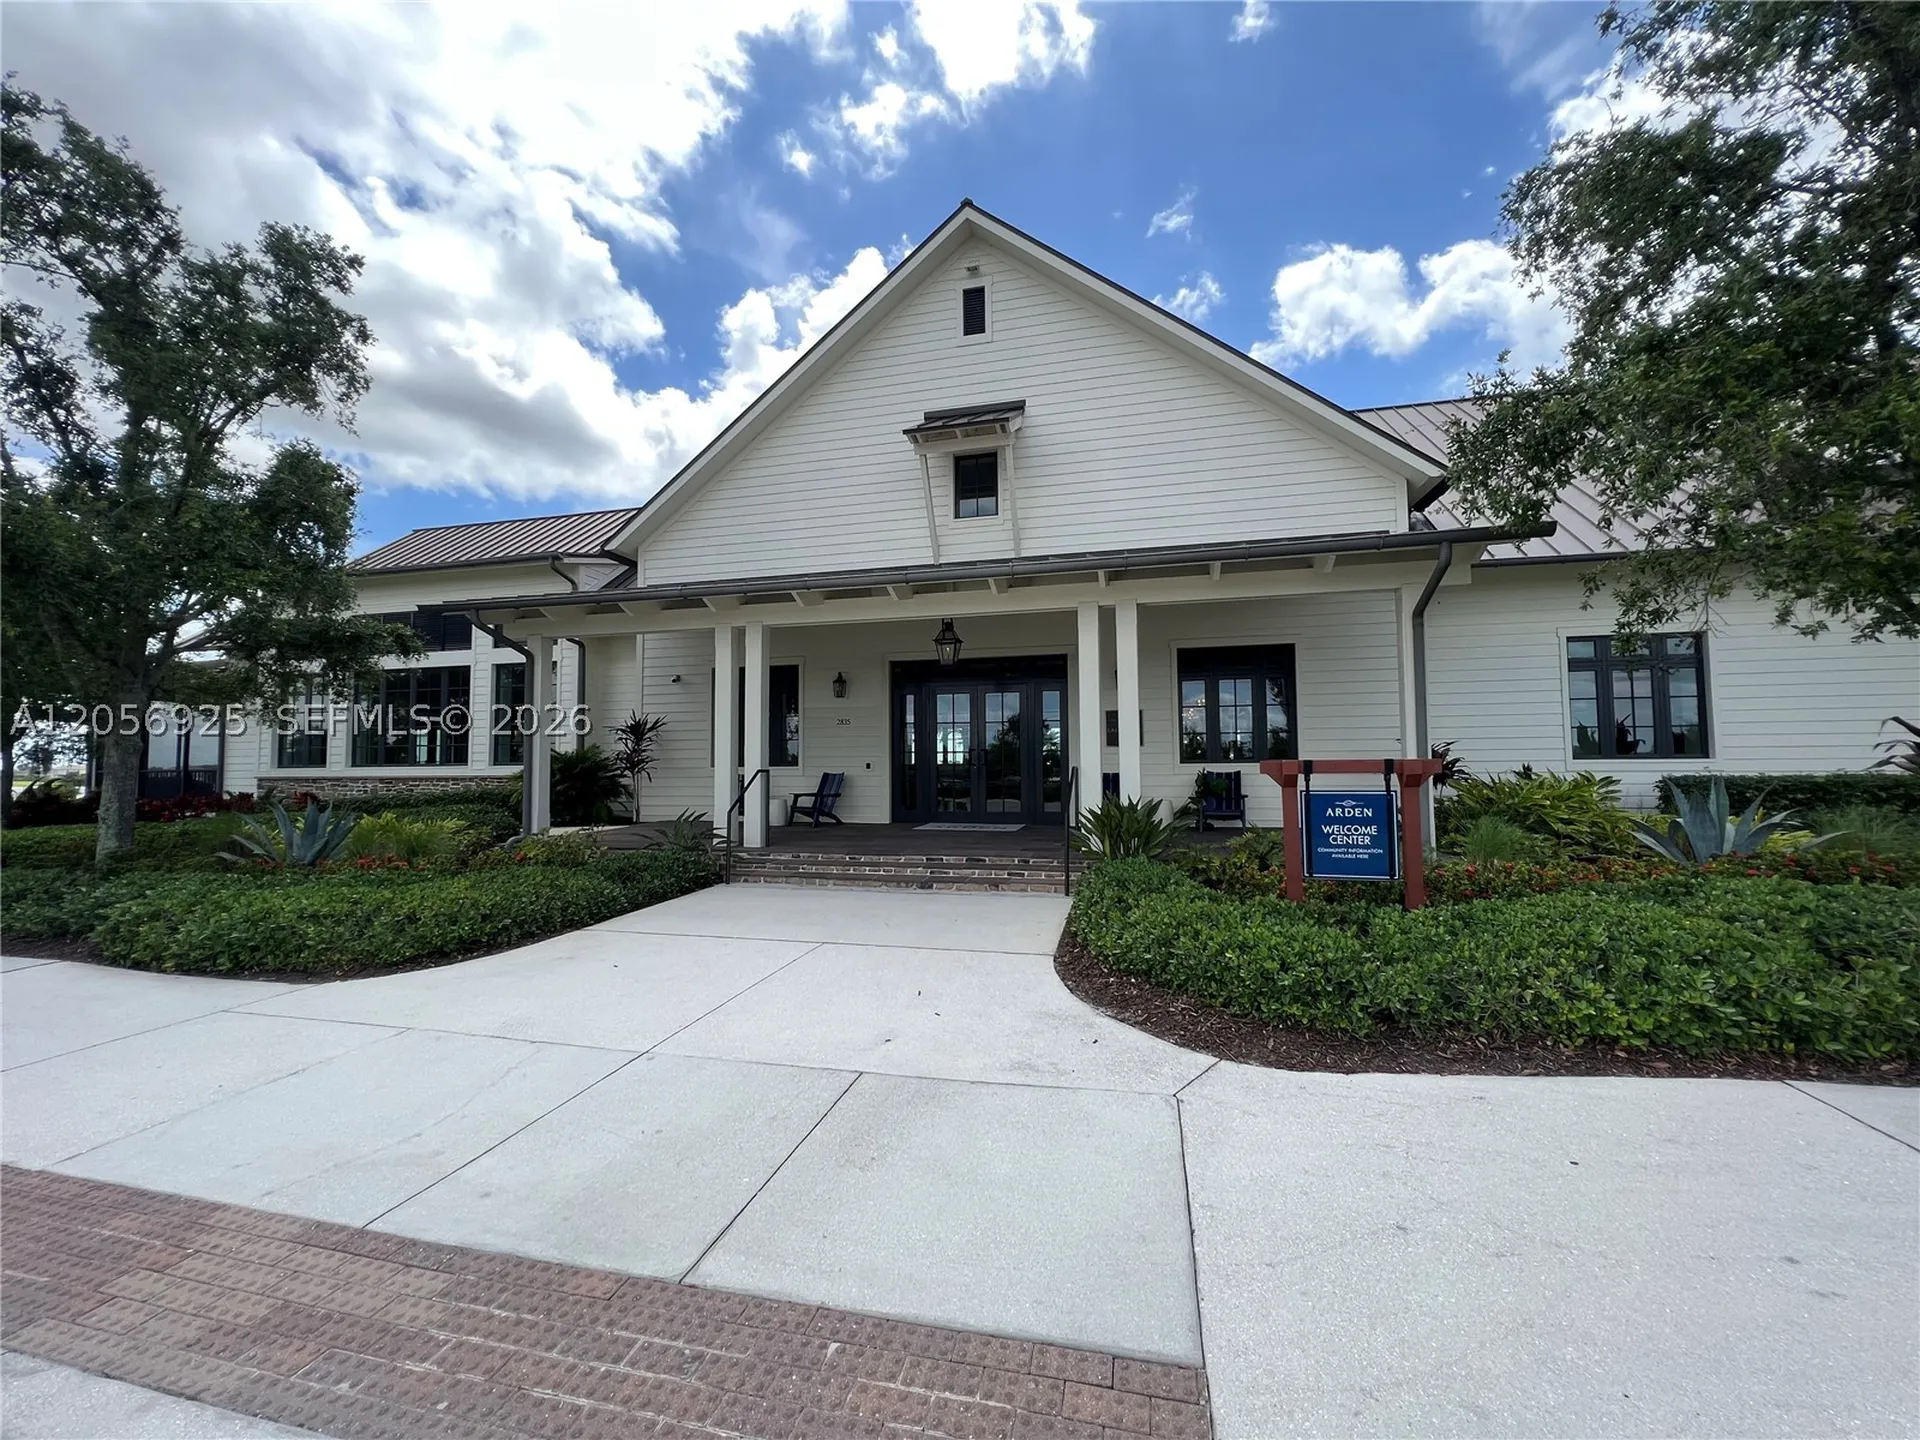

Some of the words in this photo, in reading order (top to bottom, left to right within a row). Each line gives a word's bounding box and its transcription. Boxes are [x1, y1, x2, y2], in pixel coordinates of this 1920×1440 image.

[836, 718, 851, 726] 2835
[1325, 808, 1373, 817] ARDEN
[1321, 825, 1378, 835] WELCOME
[1329, 835, 1371, 845] CENTER
